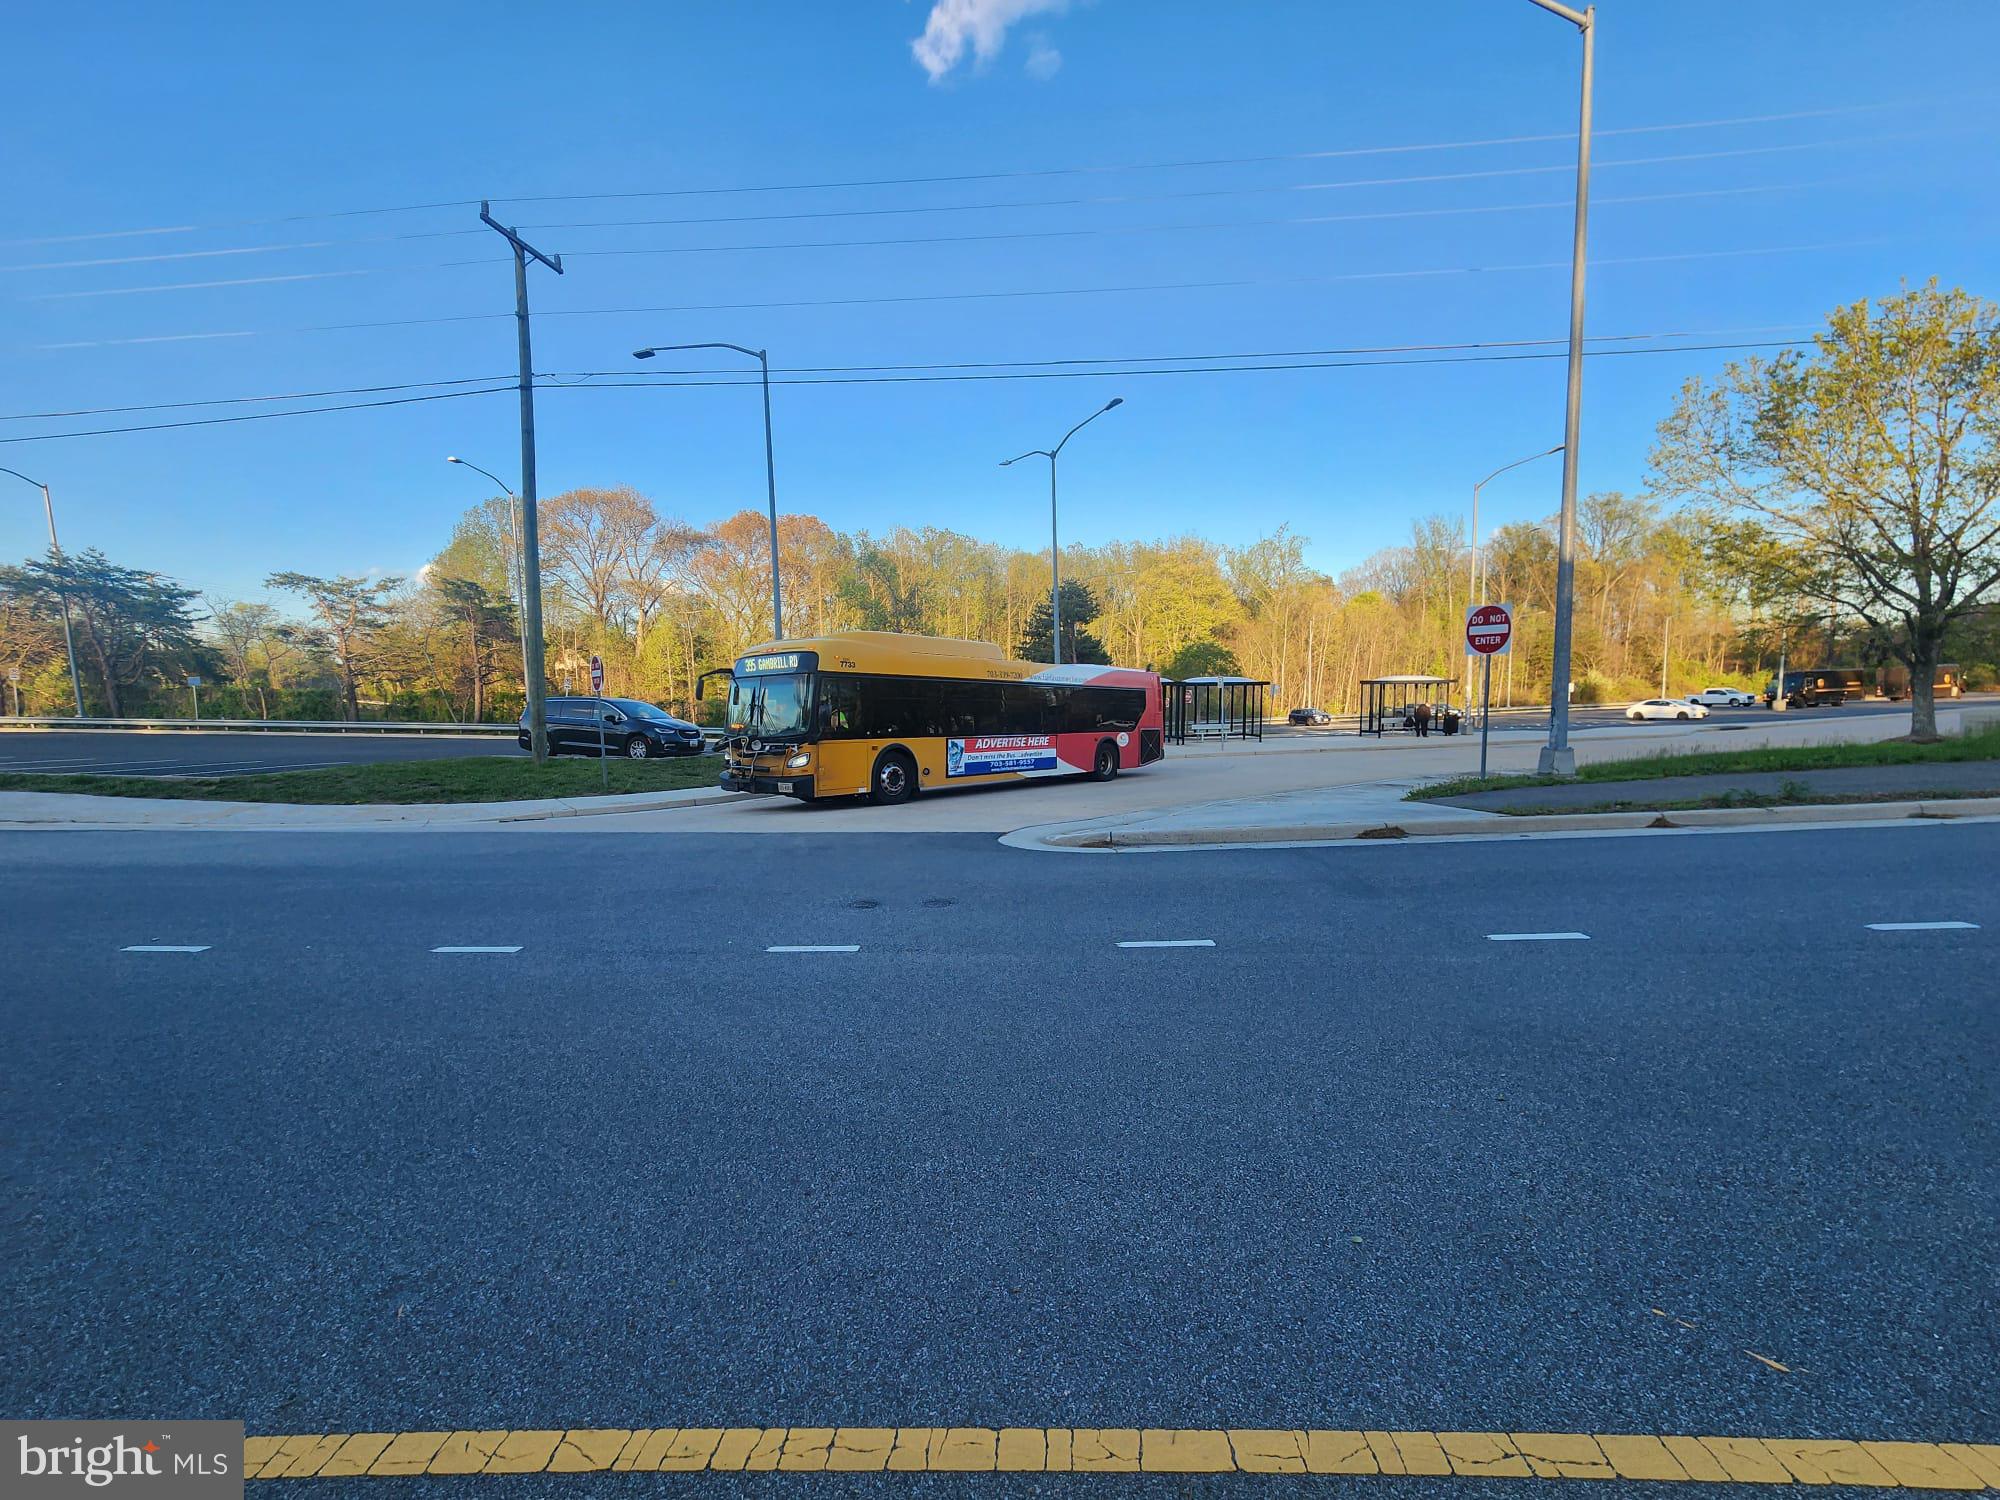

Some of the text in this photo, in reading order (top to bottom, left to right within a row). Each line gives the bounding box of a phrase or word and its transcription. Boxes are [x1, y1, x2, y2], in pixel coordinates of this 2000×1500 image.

[1472, 614, 1506, 624] DO NOT
[1475, 636, 1501, 645] ENTER
[975, 736, 1050, 749] ADVERTISE HERE
